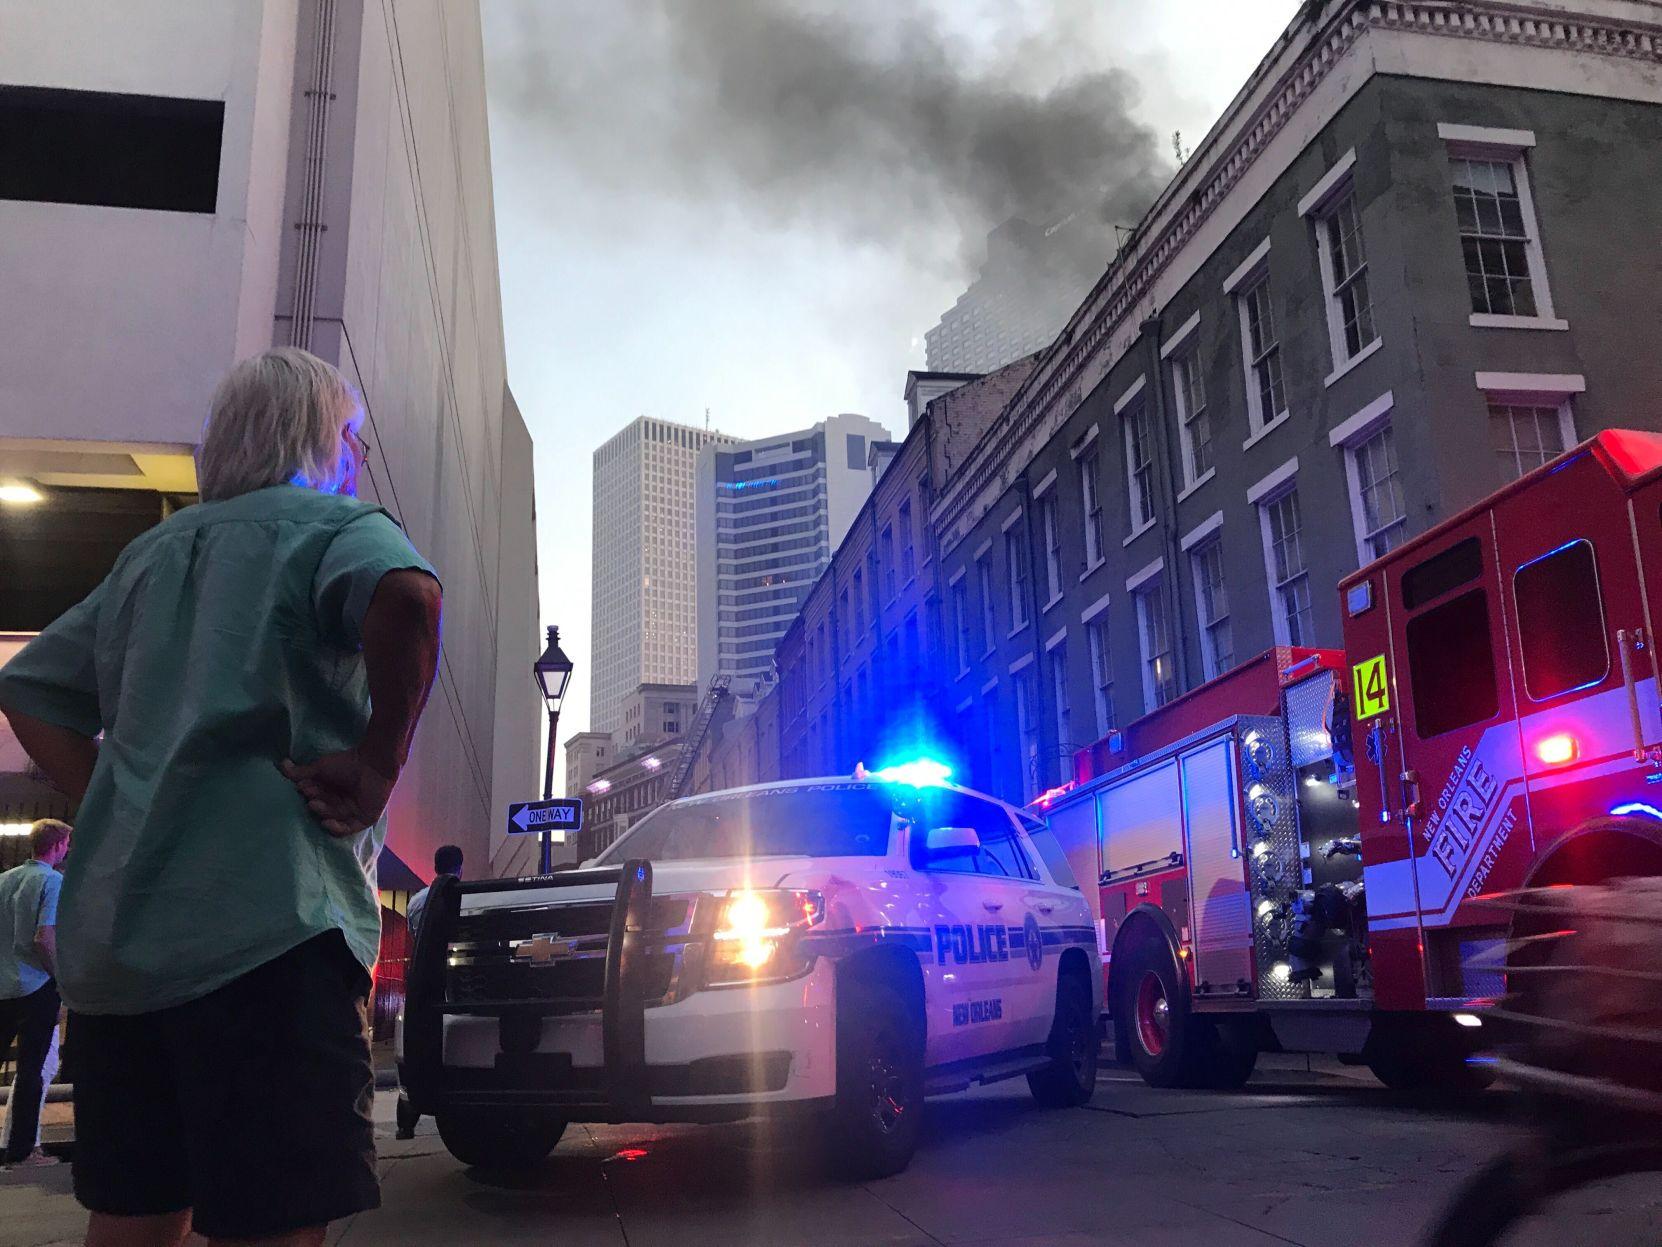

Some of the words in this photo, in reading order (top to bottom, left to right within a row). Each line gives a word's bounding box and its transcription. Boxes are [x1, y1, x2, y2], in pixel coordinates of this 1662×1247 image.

[1356, 661, 1386, 715] 14
[529, 810, 546, 823] ONE
[547, 808, 571, 821] WAY
[1422, 810, 1441, 842] NEW
[1438, 745, 1472, 809] ORLEANS
[1432, 758, 1498, 881] FIRE
[1467, 808, 1518, 900] DEPARTMENT
[934, 924, 1009, 966] POLICE
